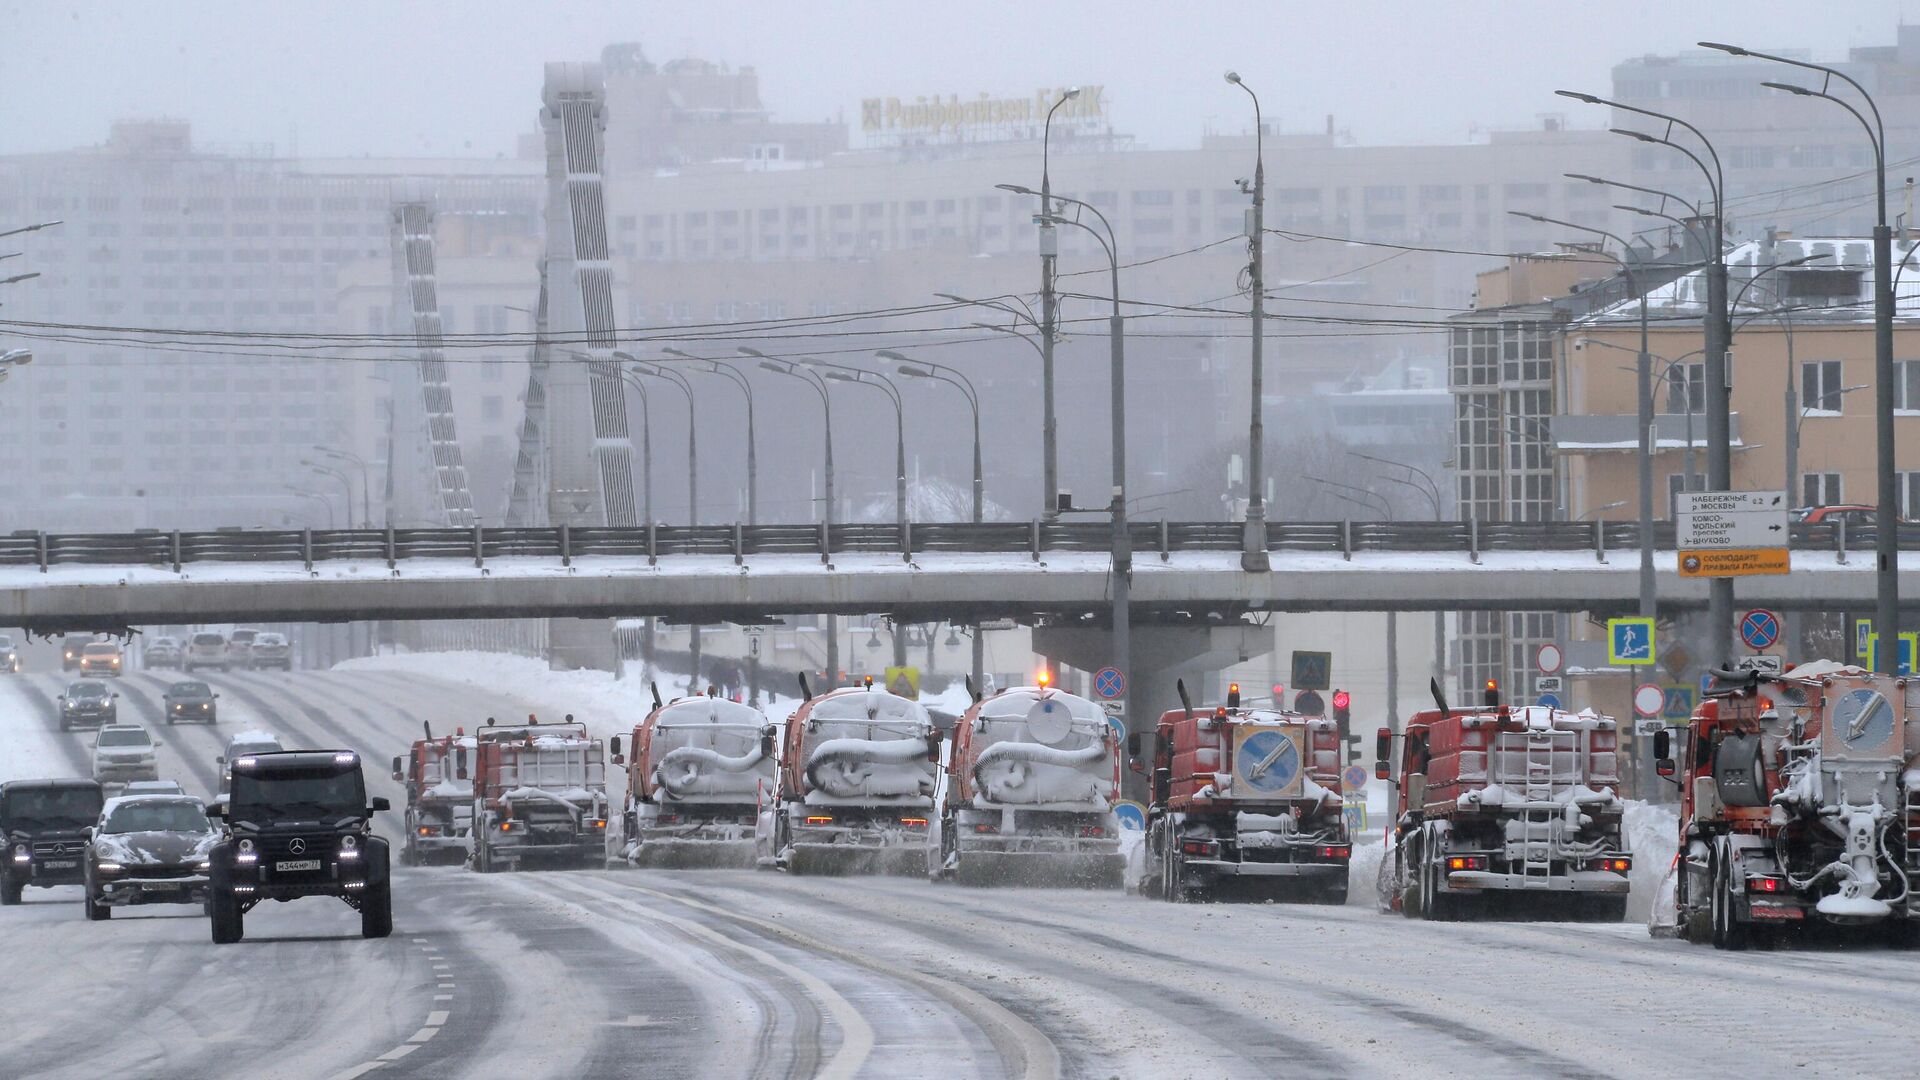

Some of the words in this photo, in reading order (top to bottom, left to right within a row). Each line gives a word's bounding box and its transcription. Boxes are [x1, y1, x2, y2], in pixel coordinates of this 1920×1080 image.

[886, 91, 1030, 134] Райффайзен
[1692, 521, 1736, 530] МОЛЬСКИЙ
[1692, 537, 1731, 545] ВНУКОВО
[1703, 563, 1740, 571] ПРАВИЛА
